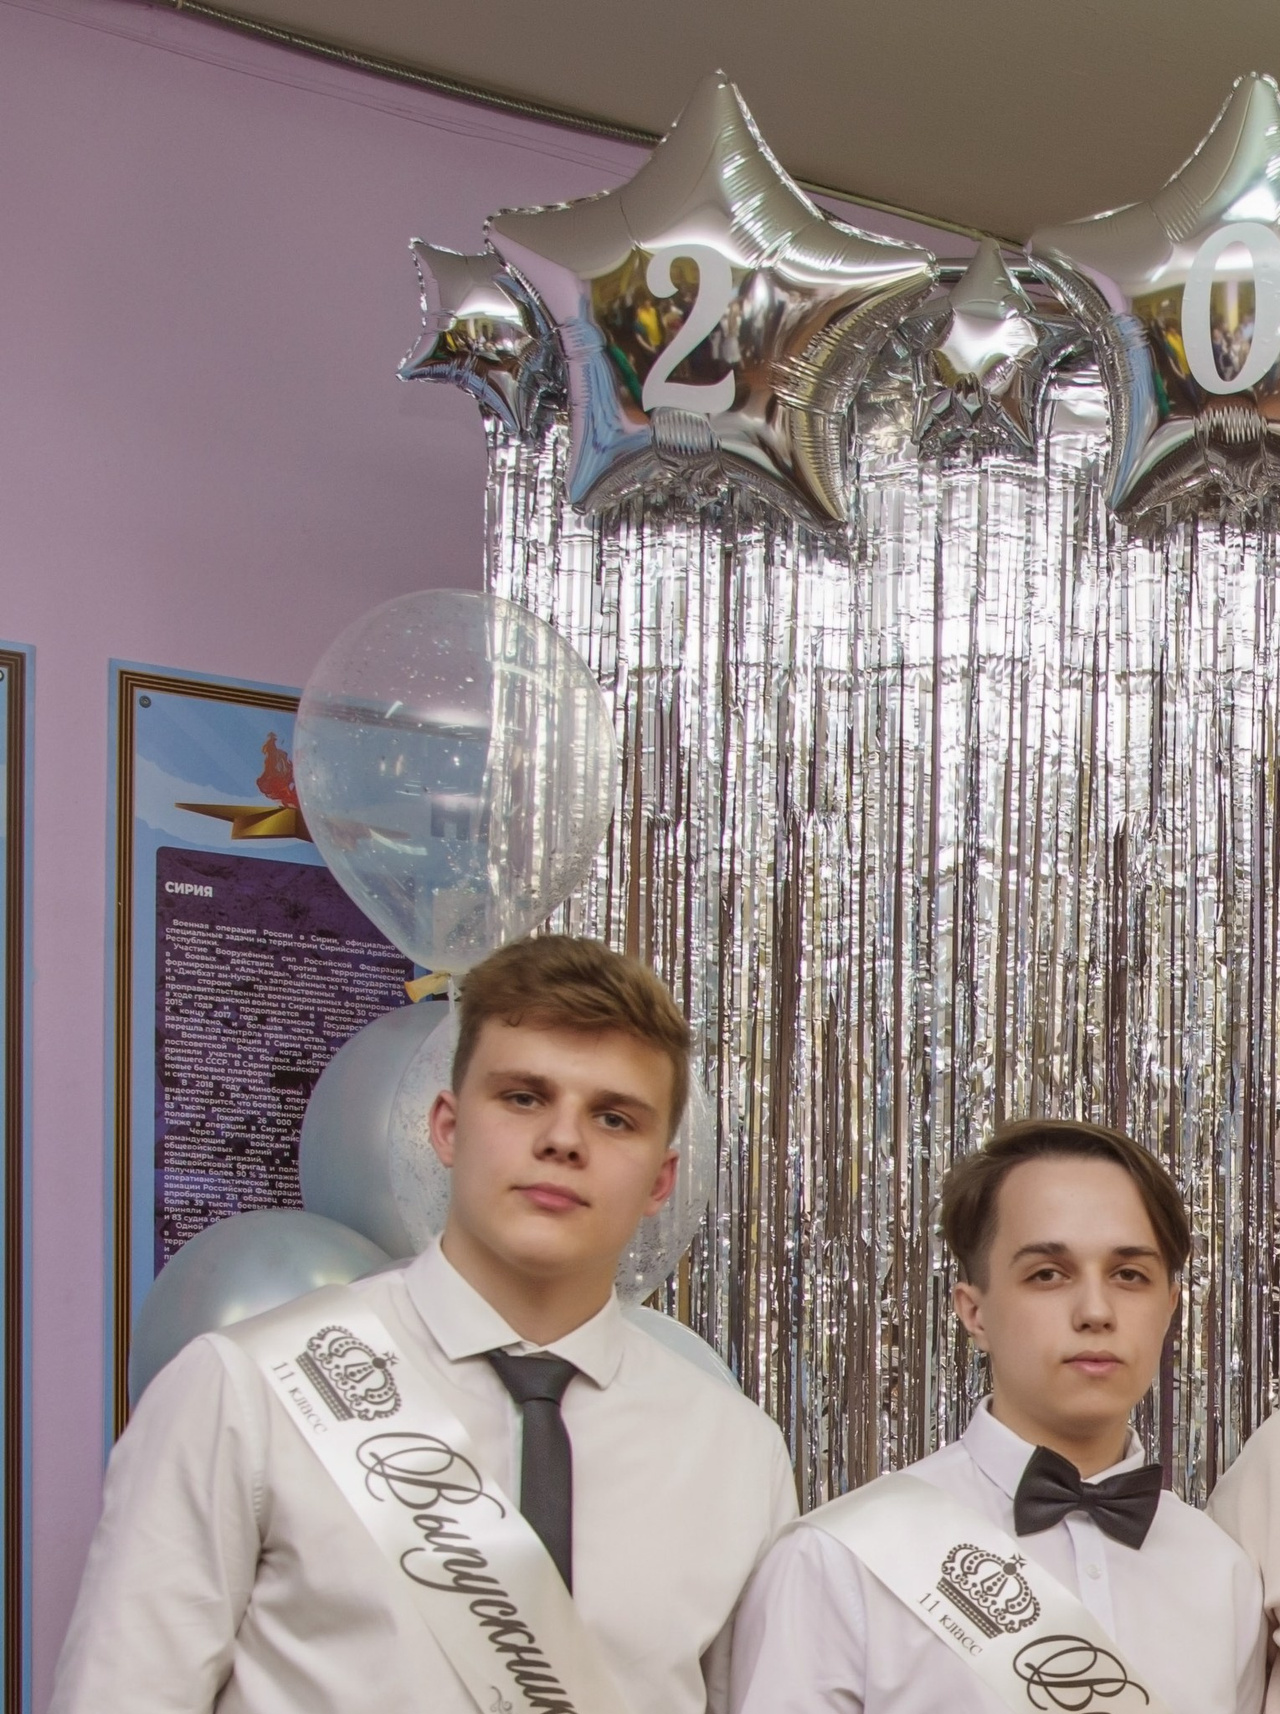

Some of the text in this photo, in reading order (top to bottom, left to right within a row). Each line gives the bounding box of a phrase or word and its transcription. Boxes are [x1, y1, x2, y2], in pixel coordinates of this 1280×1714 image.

[642, 243, 736, 411] 2
[165, 881, 213, 897] СИРИЯ
[344, 1002, 397, 1010] формирован
[323, 1022, 363, 1031] Государс
[296, 1059, 328, 1067] действ
[273, 1362, 328, 1434] 11 класс
[919, 1593, 983, 1657] 11 класс
